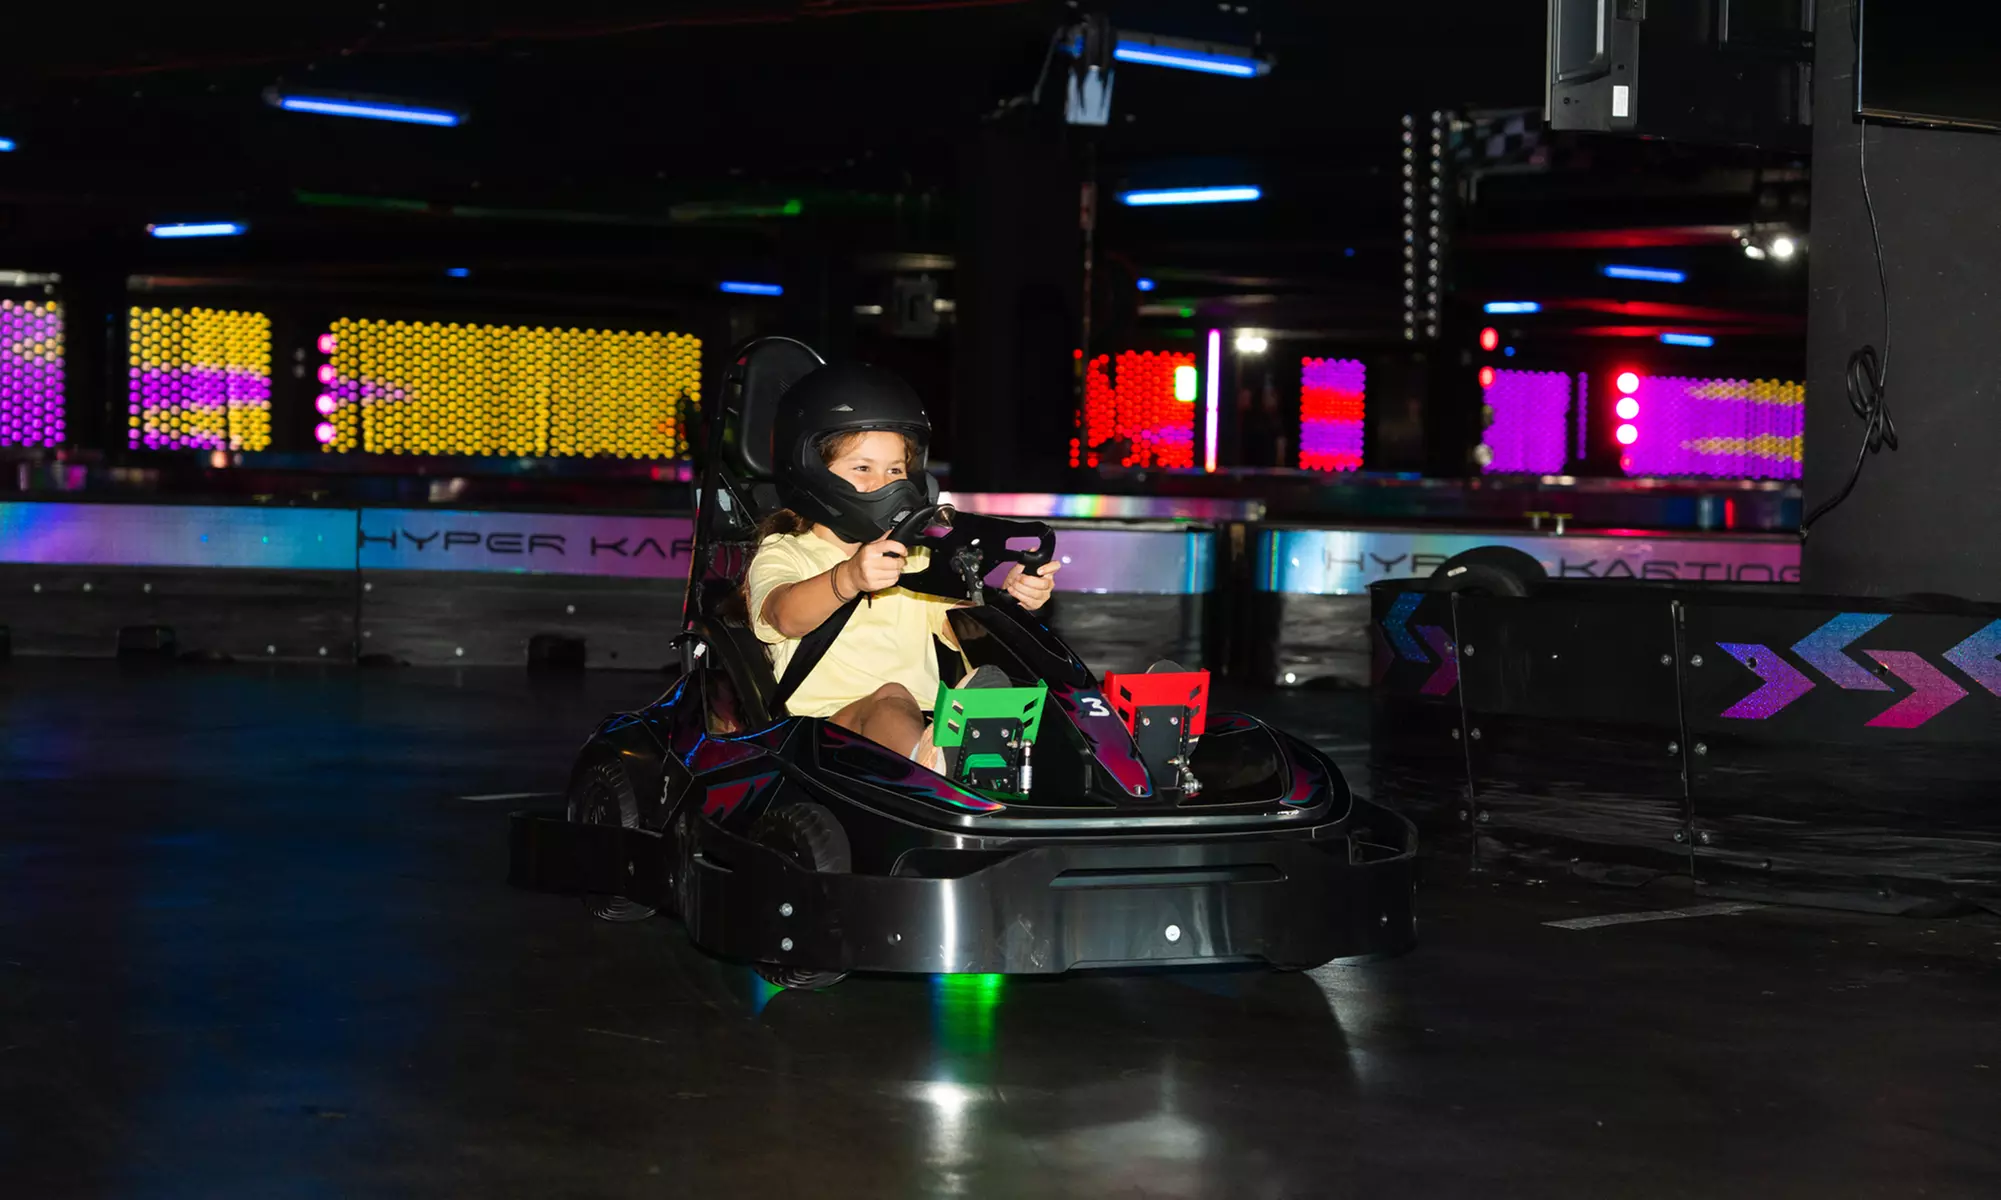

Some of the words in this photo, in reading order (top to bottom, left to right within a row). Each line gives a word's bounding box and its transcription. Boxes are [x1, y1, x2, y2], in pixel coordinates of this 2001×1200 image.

[359, 529, 566, 555] HYPER
[1327, 550, 1448, 573] HYP
[1081, 697, 1110, 717] 3
[660, 775, 670, 805] 3
